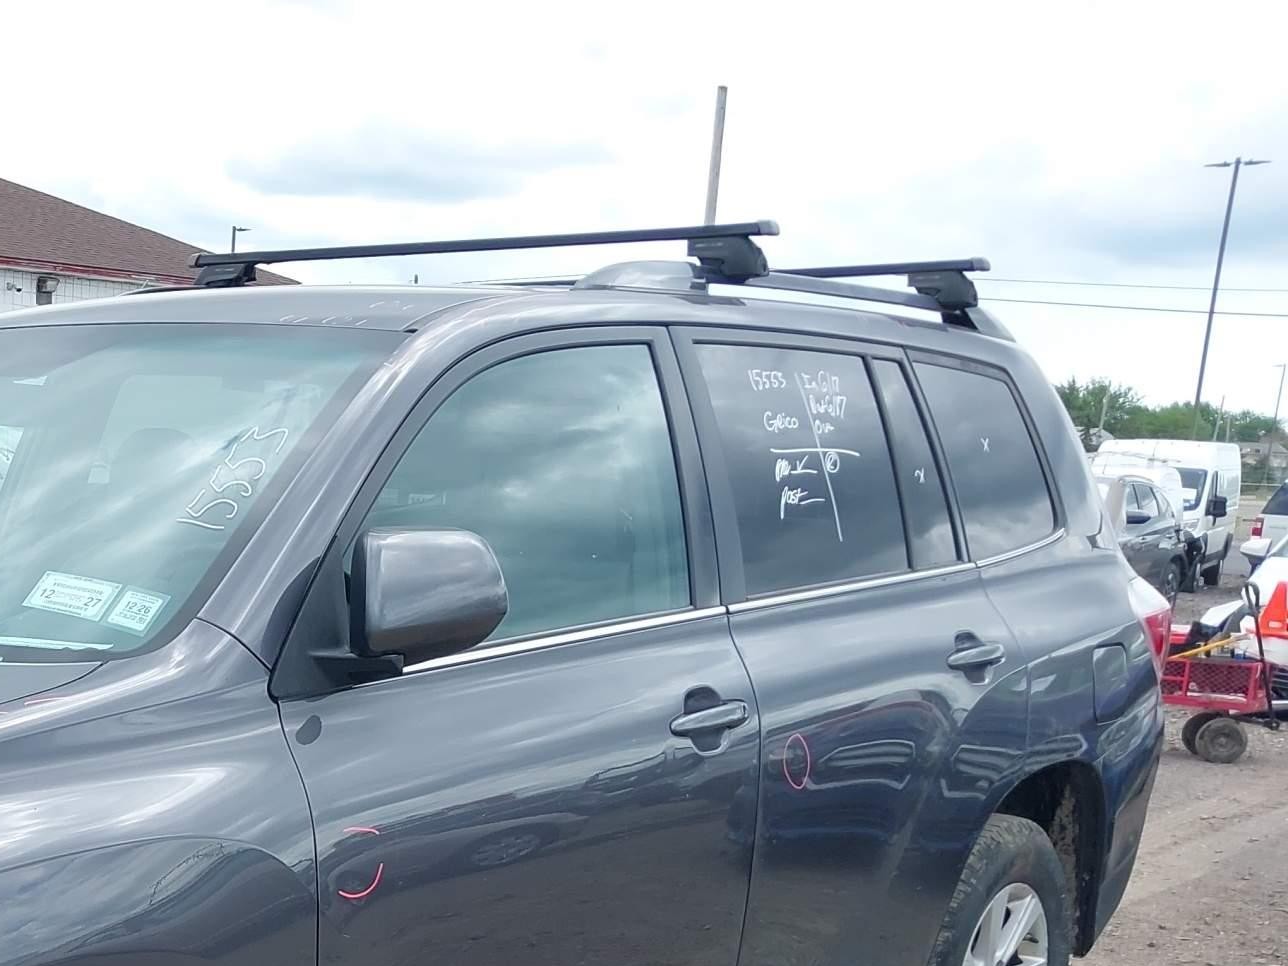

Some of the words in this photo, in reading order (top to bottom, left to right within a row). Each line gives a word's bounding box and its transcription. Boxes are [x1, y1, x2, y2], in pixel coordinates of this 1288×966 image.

[748, 369, 787, 391] 15553
[763, 411, 799, 432] Geico
[39, 588, 56, 600] 12
[83, 596, 102, 609] 27
[124, 600, 138, 611] 12
